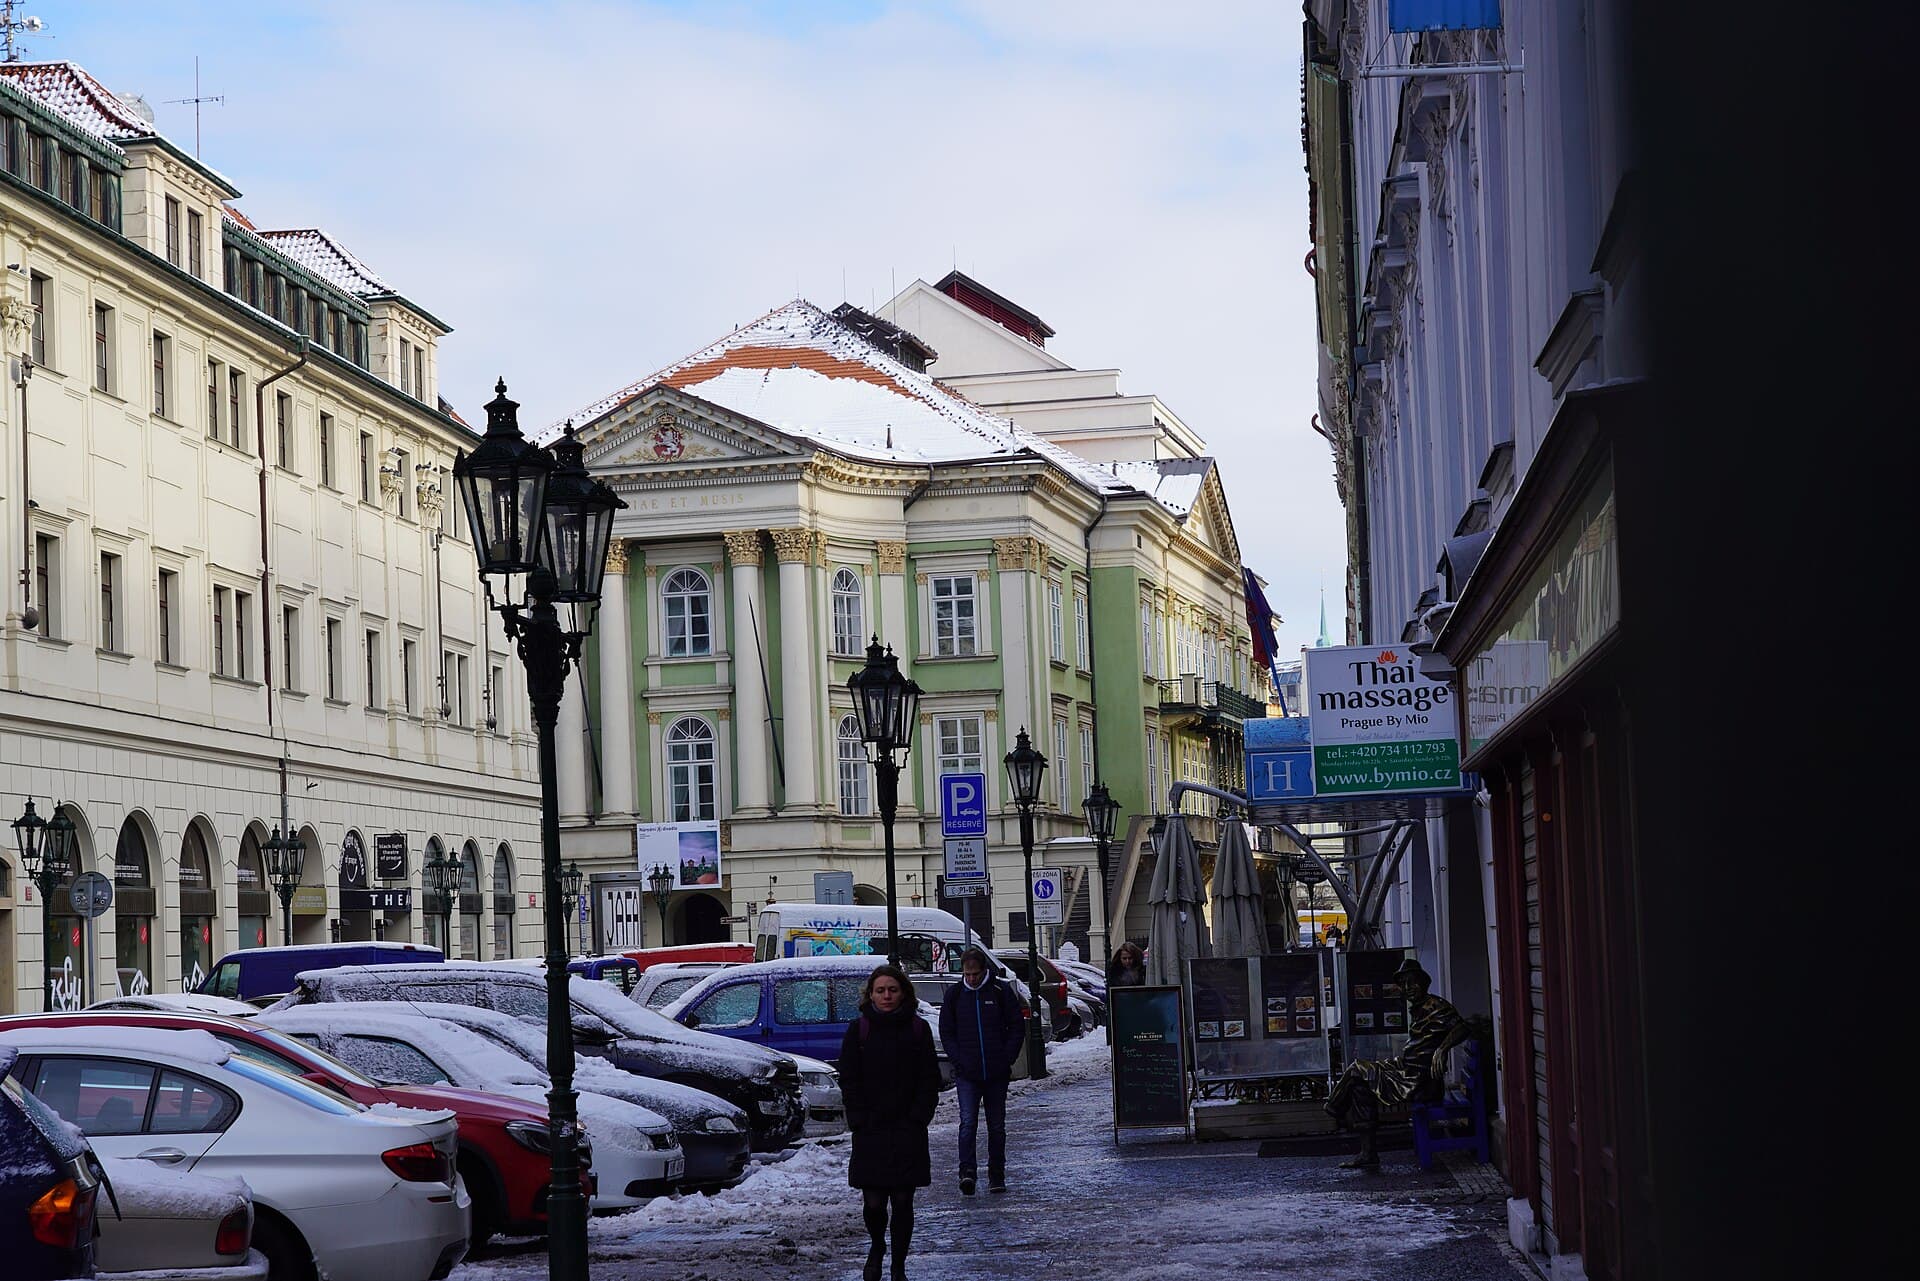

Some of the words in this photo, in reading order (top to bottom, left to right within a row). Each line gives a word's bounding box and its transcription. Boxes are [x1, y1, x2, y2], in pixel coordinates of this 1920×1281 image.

[671, 497, 687, 508] ET
[701, 494, 744, 505] MUSIS
[1349, 660, 1415, 686] Thai
[1318, 686, 1449, 711] massage
[1341, 718, 1383, 729] Prague
[1387, 715, 1402, 727] By
[1406, 714, 1429, 725] Mio
[1326, 747, 1348, 759] tel.:
[1350, 746, 1377, 757] +420
[1380, 745, 1400, 756] 734
[1403, 744, 1423, 755] 112
[1425, 743, 1446, 753] 793
[1263, 760, 1296, 791] H
[1323, 766, 1453, 788] www.bymio.cz
[951, 783, 975, 817] P
